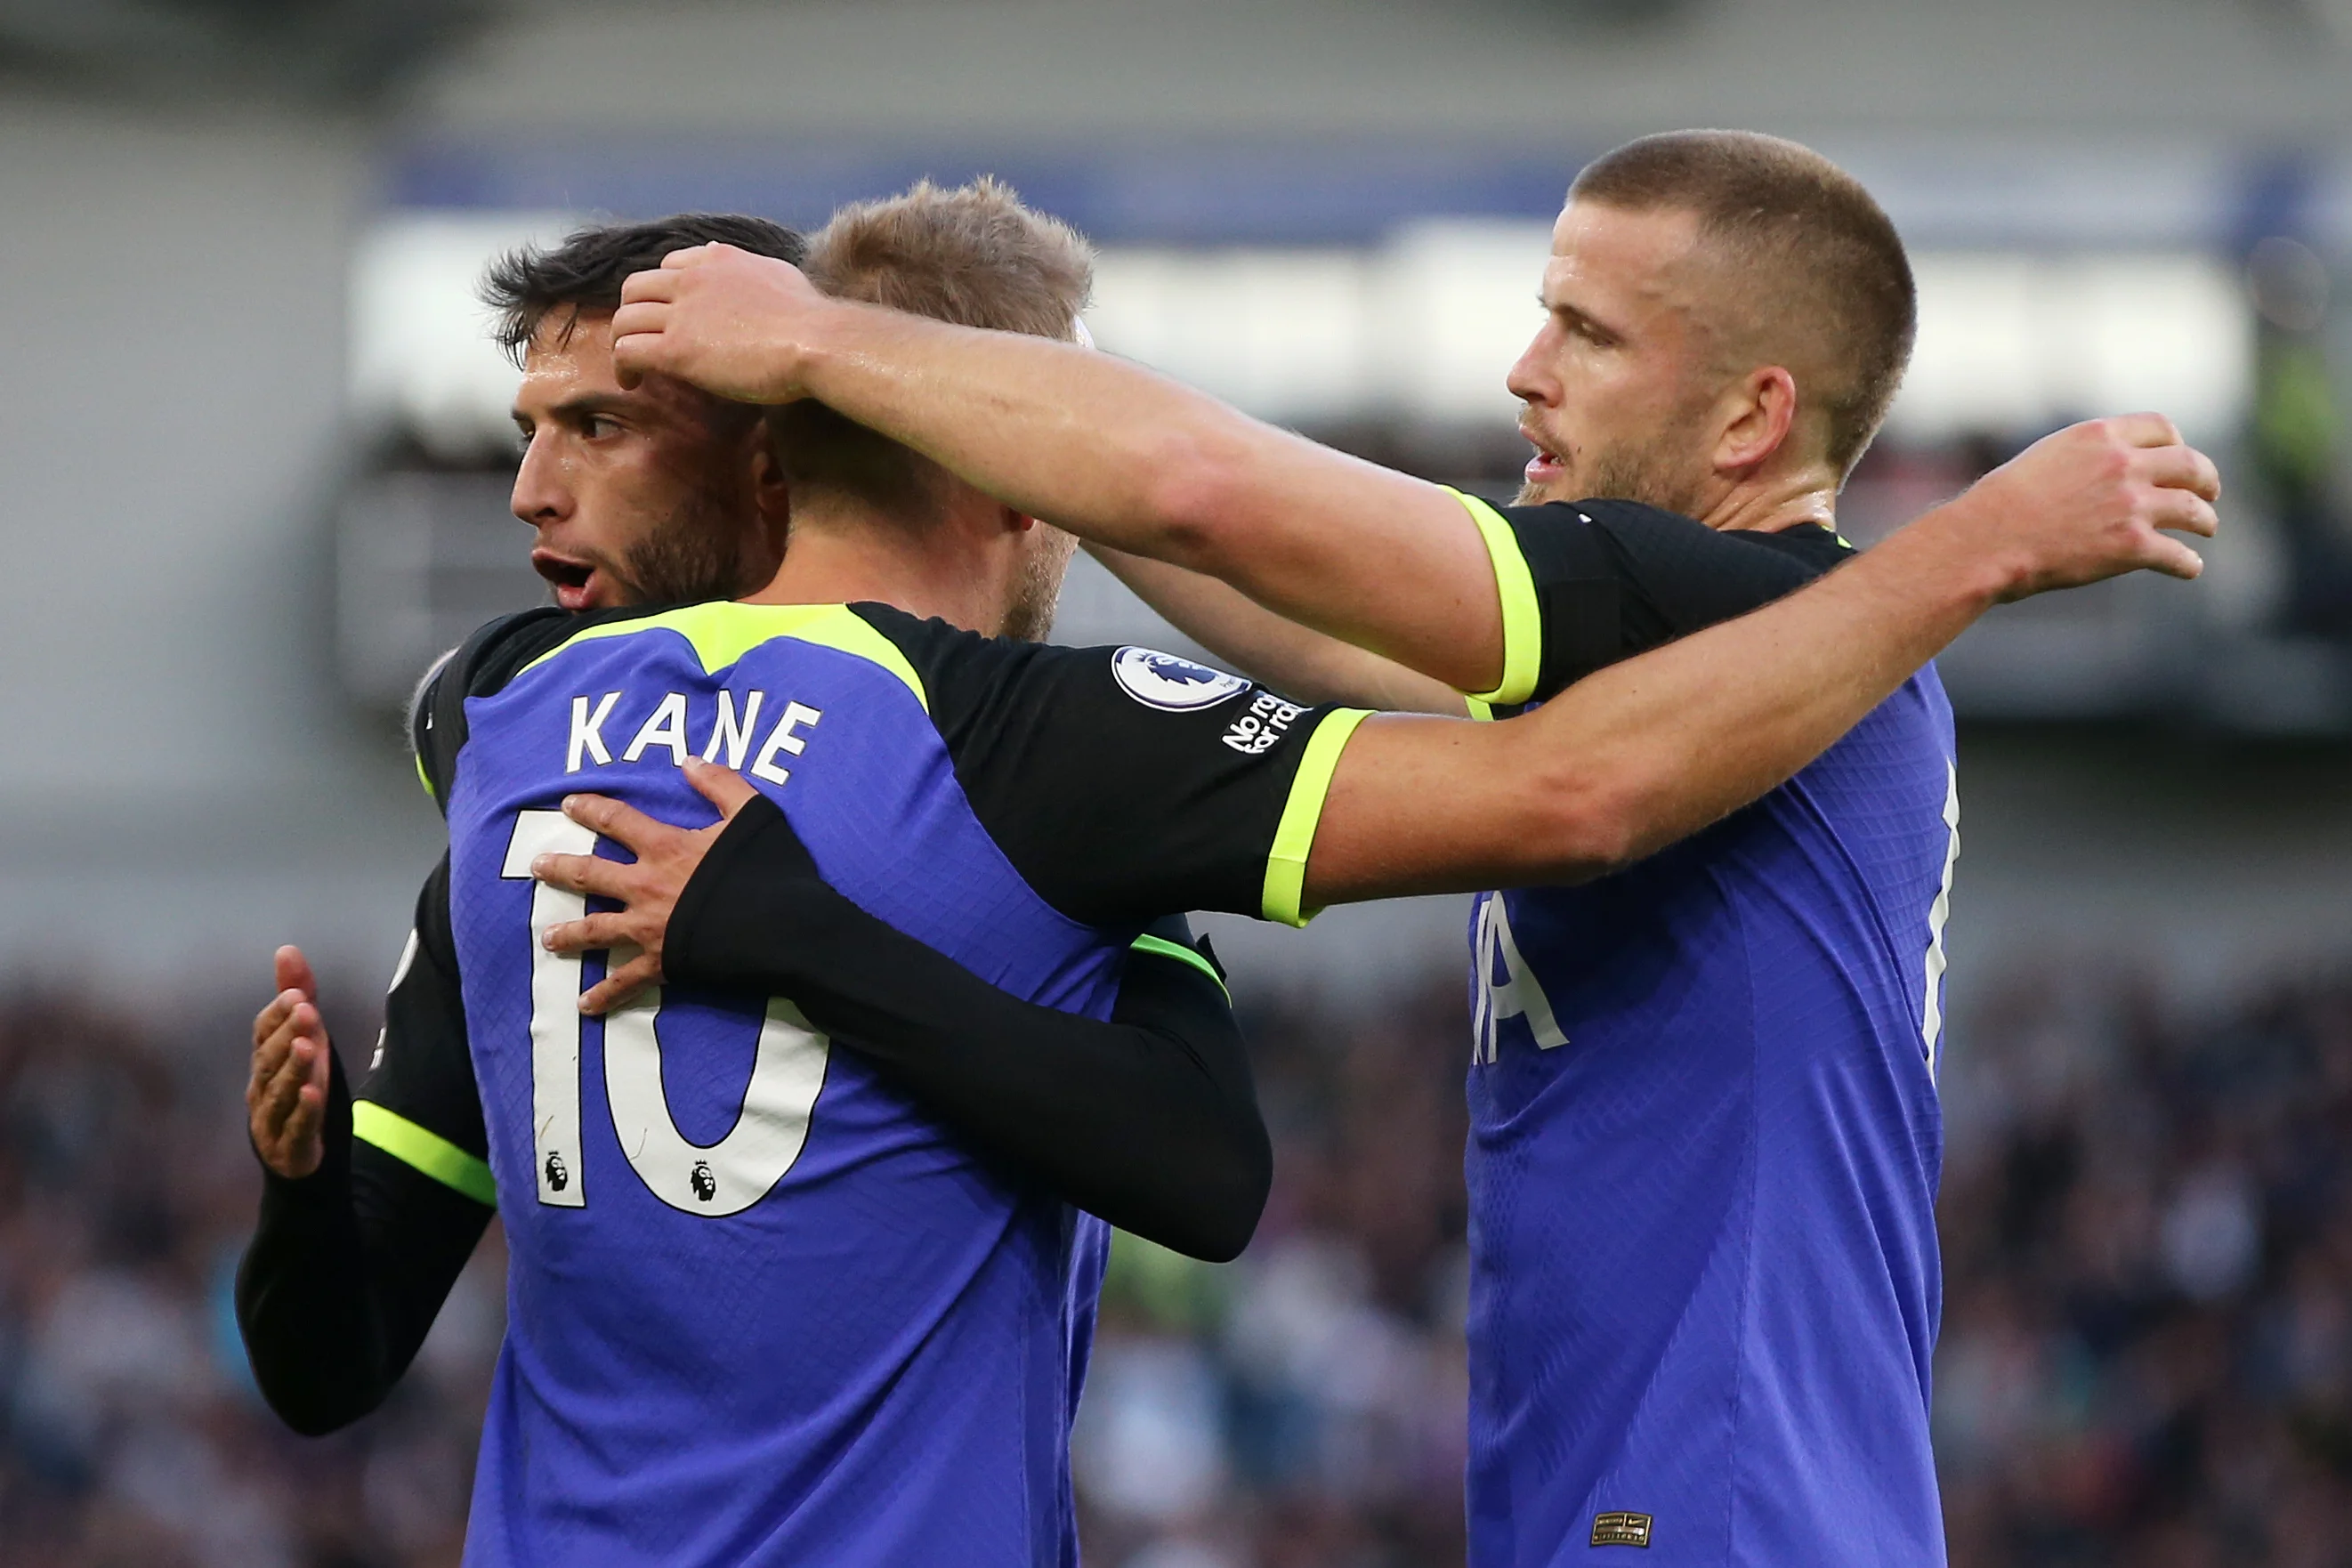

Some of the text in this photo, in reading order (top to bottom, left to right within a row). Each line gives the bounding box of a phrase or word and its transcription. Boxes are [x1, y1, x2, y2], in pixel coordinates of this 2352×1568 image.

[565, 690, 822, 786] KANE
[1222, 715, 1261, 752] No
[499, 809, 830, 1217] 10
